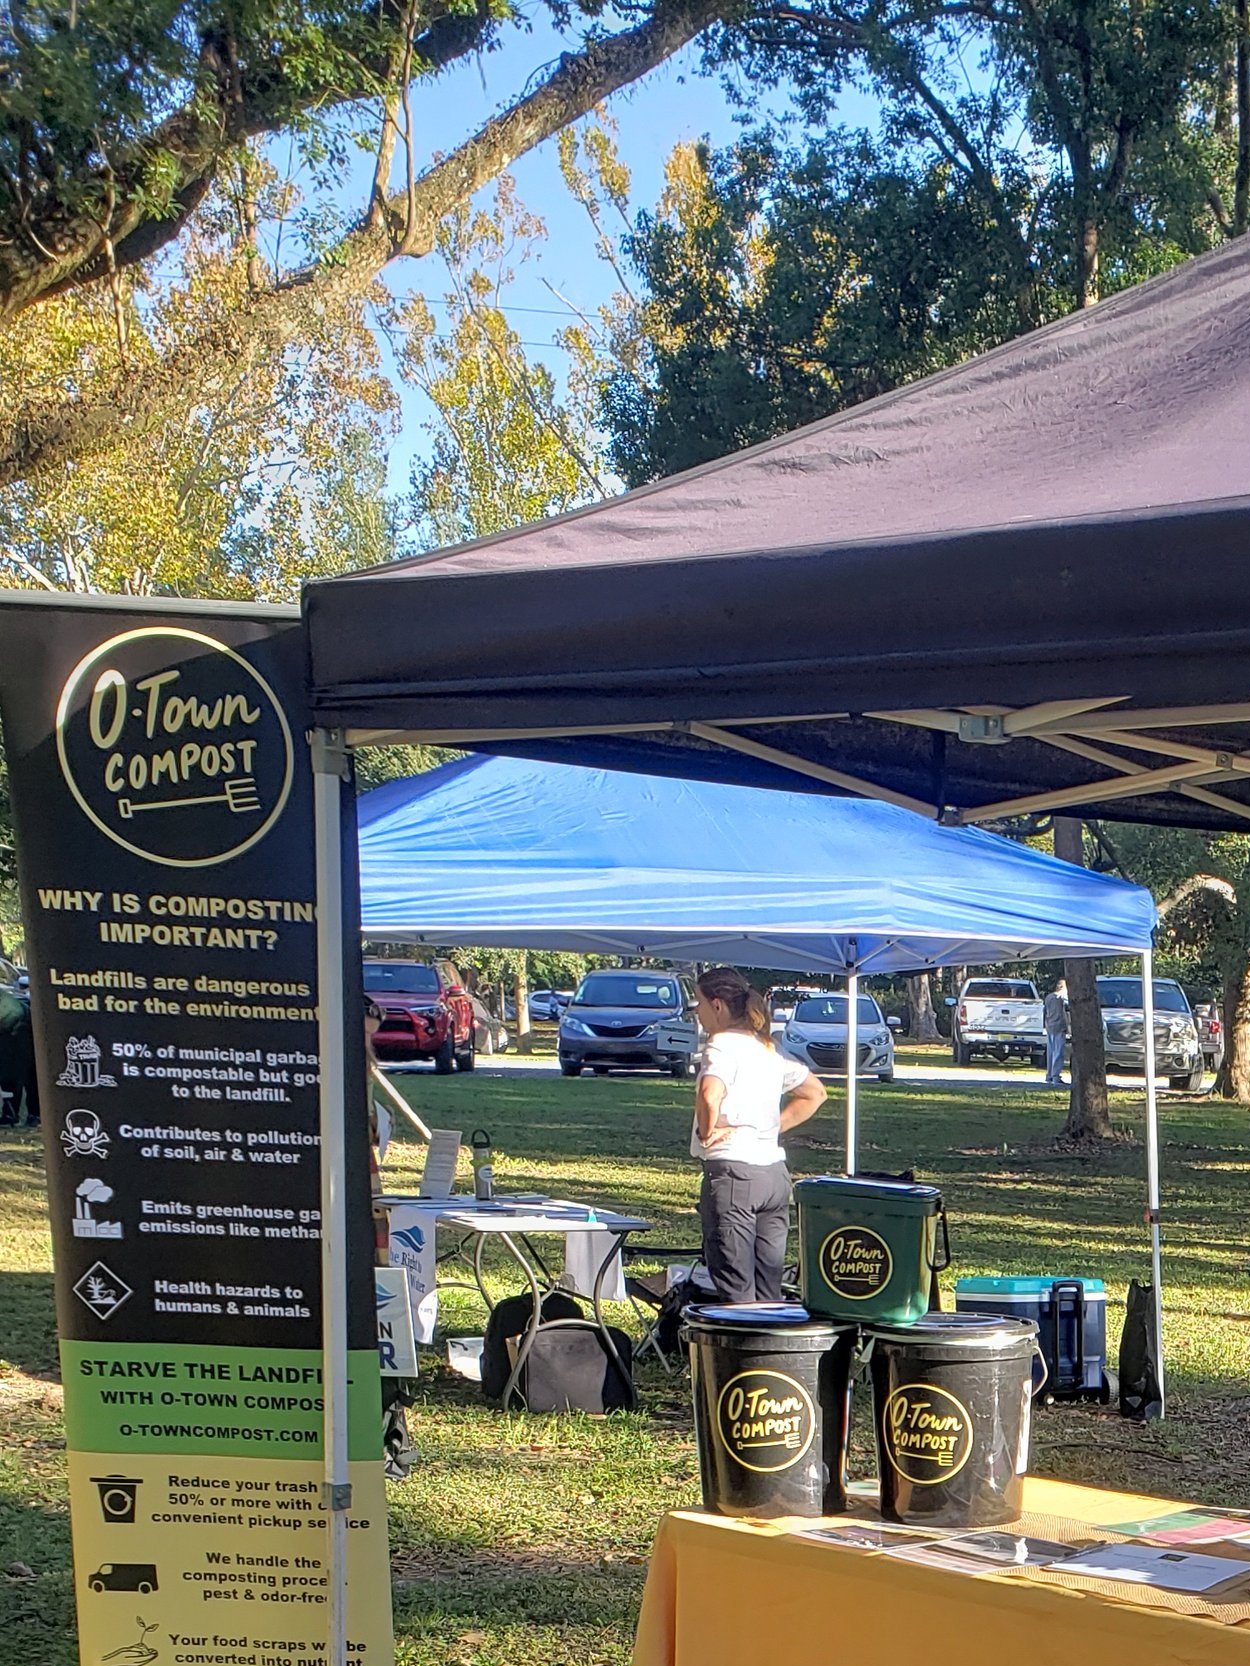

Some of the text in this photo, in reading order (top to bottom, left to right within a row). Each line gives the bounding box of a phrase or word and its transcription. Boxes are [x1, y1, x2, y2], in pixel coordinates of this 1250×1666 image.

[105, 740, 258, 793] COMPOST
[38, 889, 318, 923] WHY IS COMPOSTIN
[100, 922, 278, 950] IMPORTANT?
[50, 968, 311, 998] Landfills are dangerous
[58, 993, 98, 1012] bad
[105, 996, 138, 1013] for
[144, 997, 181, 1016] the
[112, 1043, 152, 1058] 50%
[157, 1045, 176, 1059] of
[179, 1048, 262, 1065] municipal
[266, 1051, 322, 1066] garba
[123, 1063, 139, 1076] is
[144, 1065, 254, 1082] compostable
[259, 1069, 289, 1083] but
[172, 1084, 291, 1102] to the landfill.
[119, 1124, 222, 1141] Contributes
[225, 1130, 242, 1143] to
[141, 1144, 301, 1164] of soil, air & water
[141, 1200, 321, 1223] Emits greenhouse ga
[139, 1220, 323, 1239] emissions like metha
[830, 1237, 885, 1261] O-Town
[831, 1261, 882, 1274] COMPOST
[155, 1280, 303, 1299] Health hazards to
[155, 1299, 310, 1318] humans & animals
[80, 1359, 353, 1384] STARVE THE LANDFI
[100, 1390, 325, 1411] WITH O-TOWN COMPOS
[728, 1387, 803, 1420] O-Town
[893, 1396, 963, 1431] O-Town
[120, 1424, 318, 1443] O-TOWNCOMPOST.COM
[732, 1416, 801, 1439] COMPOST
[893, 1430, 957, 1450] COMPOST
[168, 1475, 318, 1493] Reduce your trash
[168, 1494, 204, 1506] 50%
[210, 1496, 226, 1506] or
[231, 1498, 271, 1509] more
[278, 1498, 312, 1511] with
[152, 1511, 370, 1530] convenient pickup seice
[206, 1552, 321, 1569] We handle the
[183, 1571, 276, 1587] composting
[203, 1588, 327, 1603] pest & odor-fre
[169, 1634, 208, 1647] Your
[213, 1635, 248, 1648] food
[253, 1638, 306, 1653] scraps
[346, 1641, 366, 1652] be
[175, 1653, 257, 1665] converted
[261, 1655, 292, 1666] into
